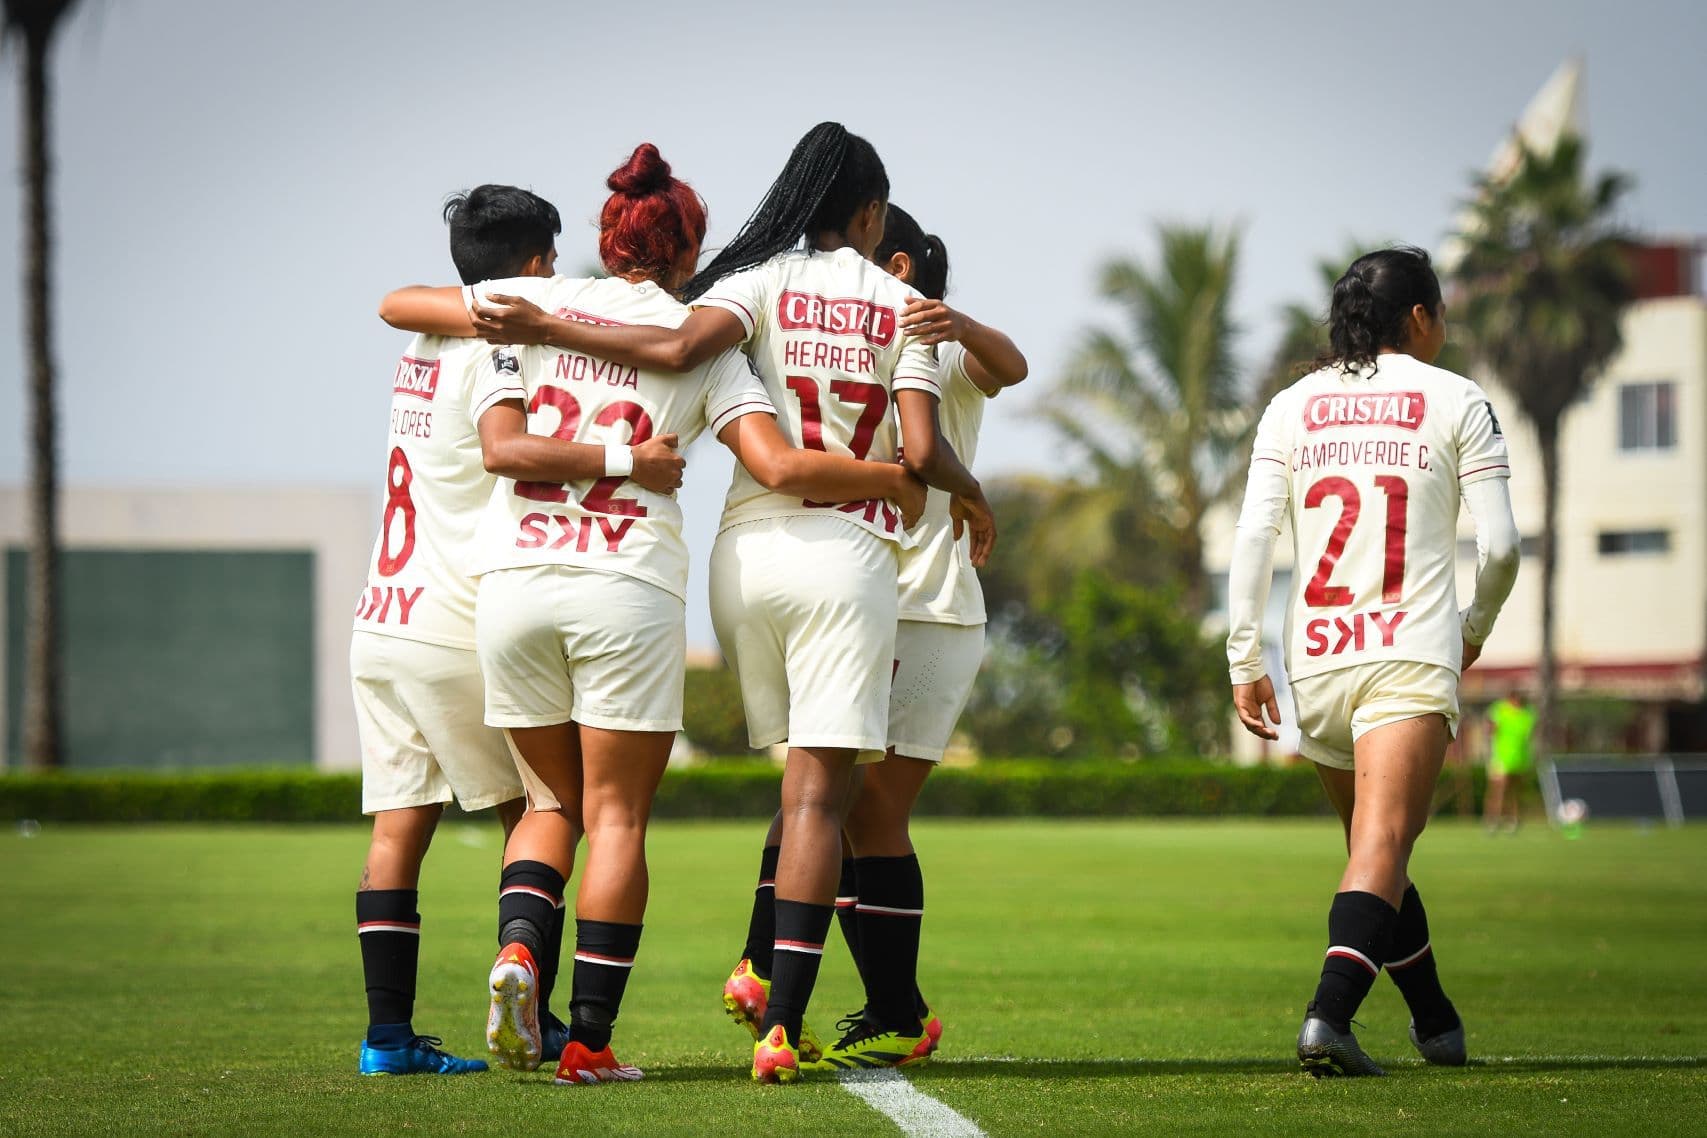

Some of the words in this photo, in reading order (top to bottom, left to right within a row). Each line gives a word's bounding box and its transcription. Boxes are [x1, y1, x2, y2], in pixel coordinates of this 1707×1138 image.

[786, 297, 887, 339] CRISTAL
[556, 353, 638, 391] NOVOA
[786, 376, 888, 462] 17
[1311, 396, 1417, 425] CRISTAL
[514, 384, 654, 518] 22
[1418, 444, 1434, 472] C.
[378, 446, 416, 578] 8
[516, 512, 636, 553] SKY
[1304, 475, 1409, 608] 21
[1306, 611, 1409, 657] SKY
